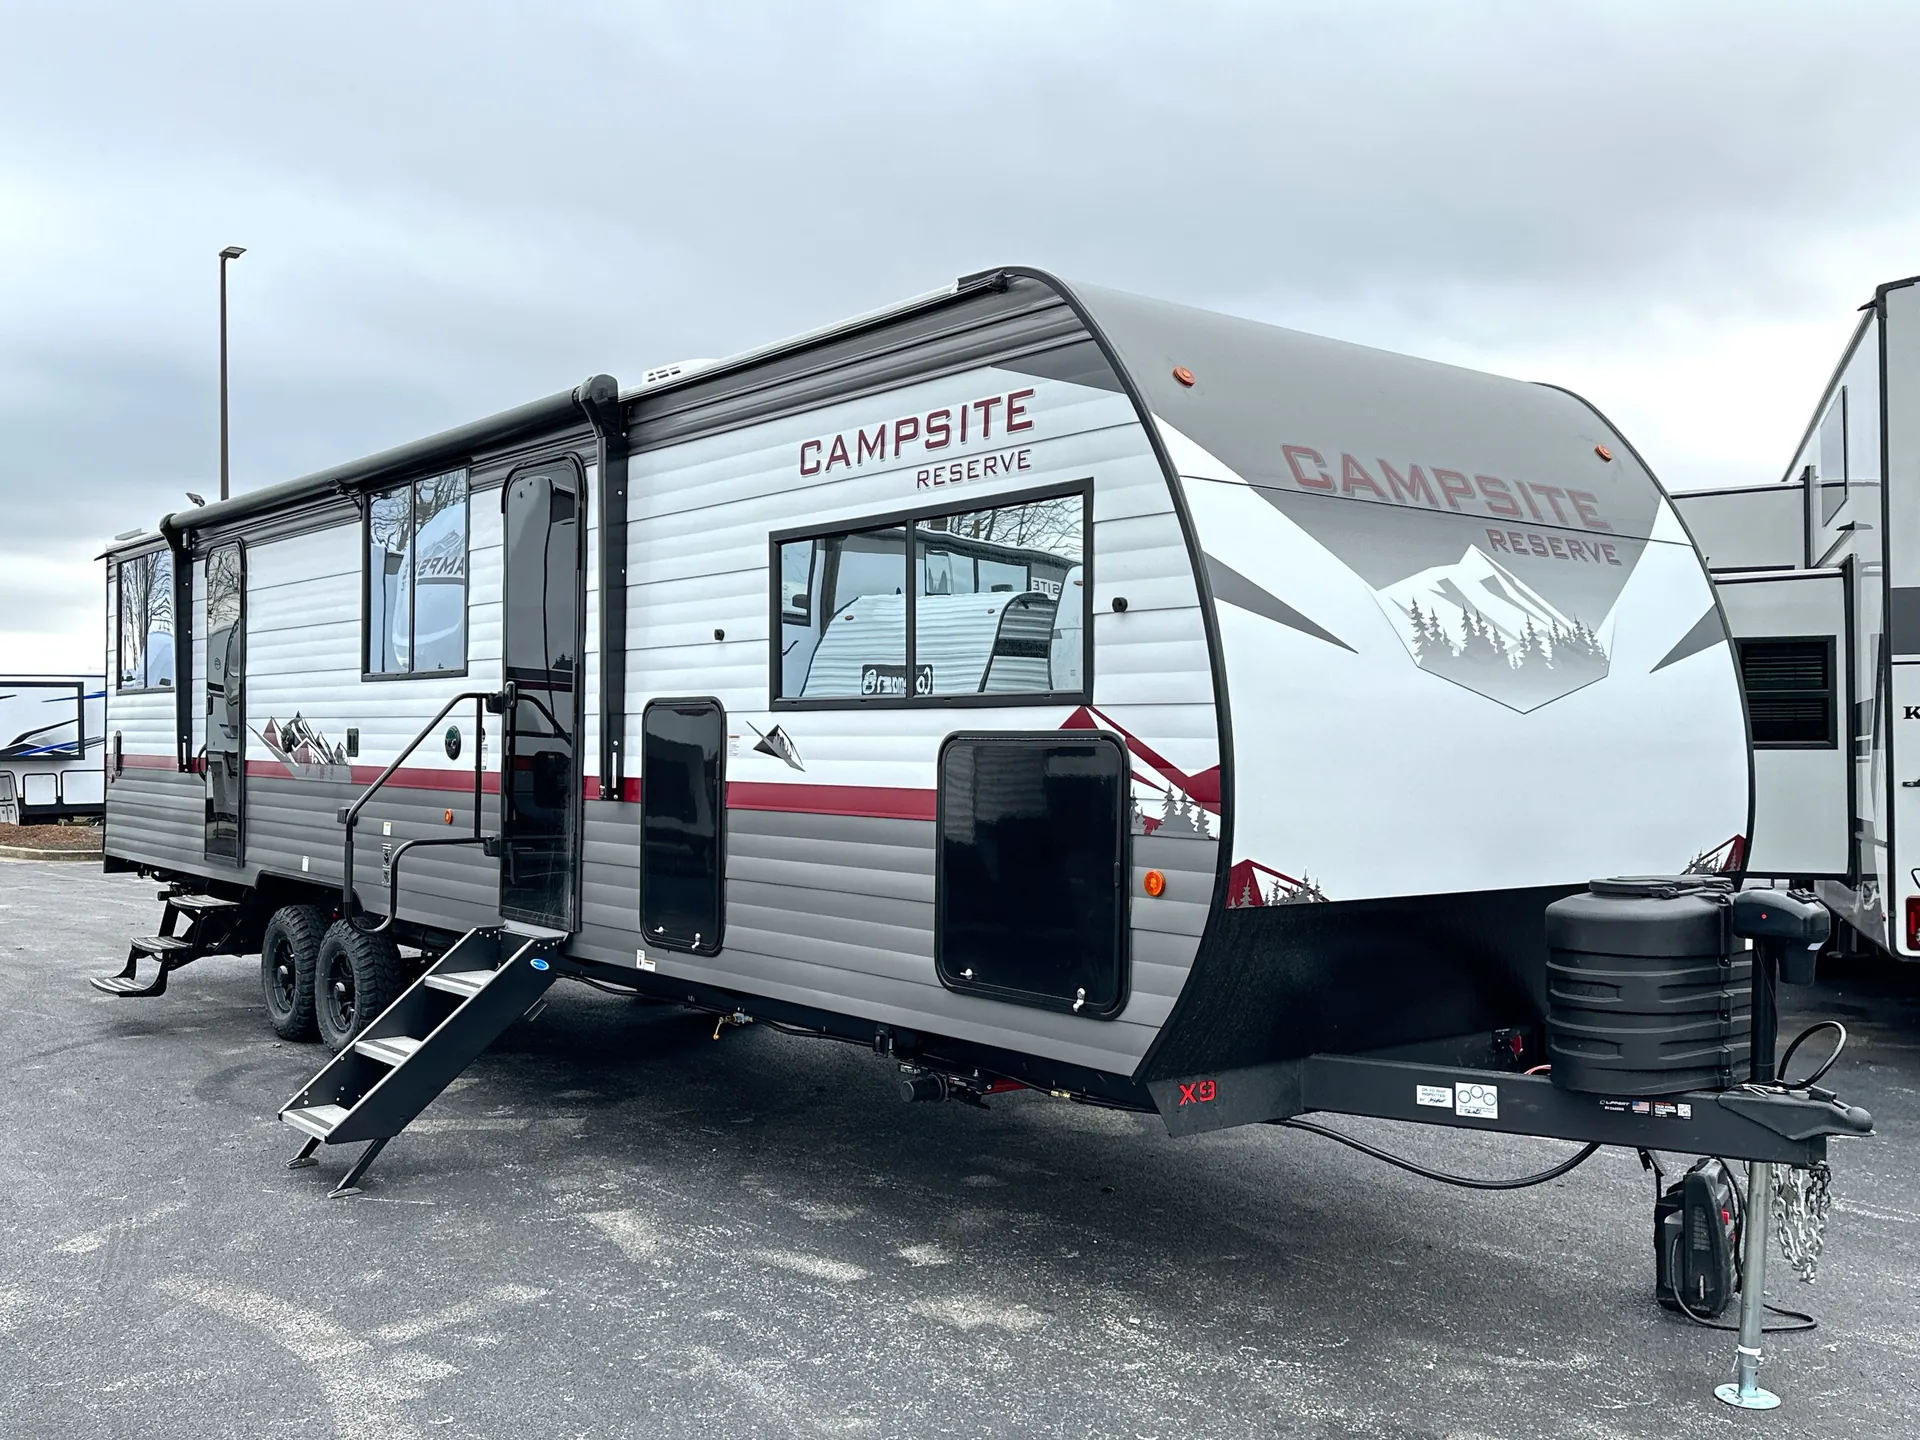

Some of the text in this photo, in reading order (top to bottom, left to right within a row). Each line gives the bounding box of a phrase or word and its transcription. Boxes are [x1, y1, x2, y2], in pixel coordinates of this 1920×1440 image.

[799, 388, 1034, 476] CAMPSITE
[916, 449, 1032, 489] RESERVE
[1280, 443, 1613, 531] CAMPSITE
[1484, 528, 1623, 567] RESERVE
[1179, 1080, 1216, 1105] X9
